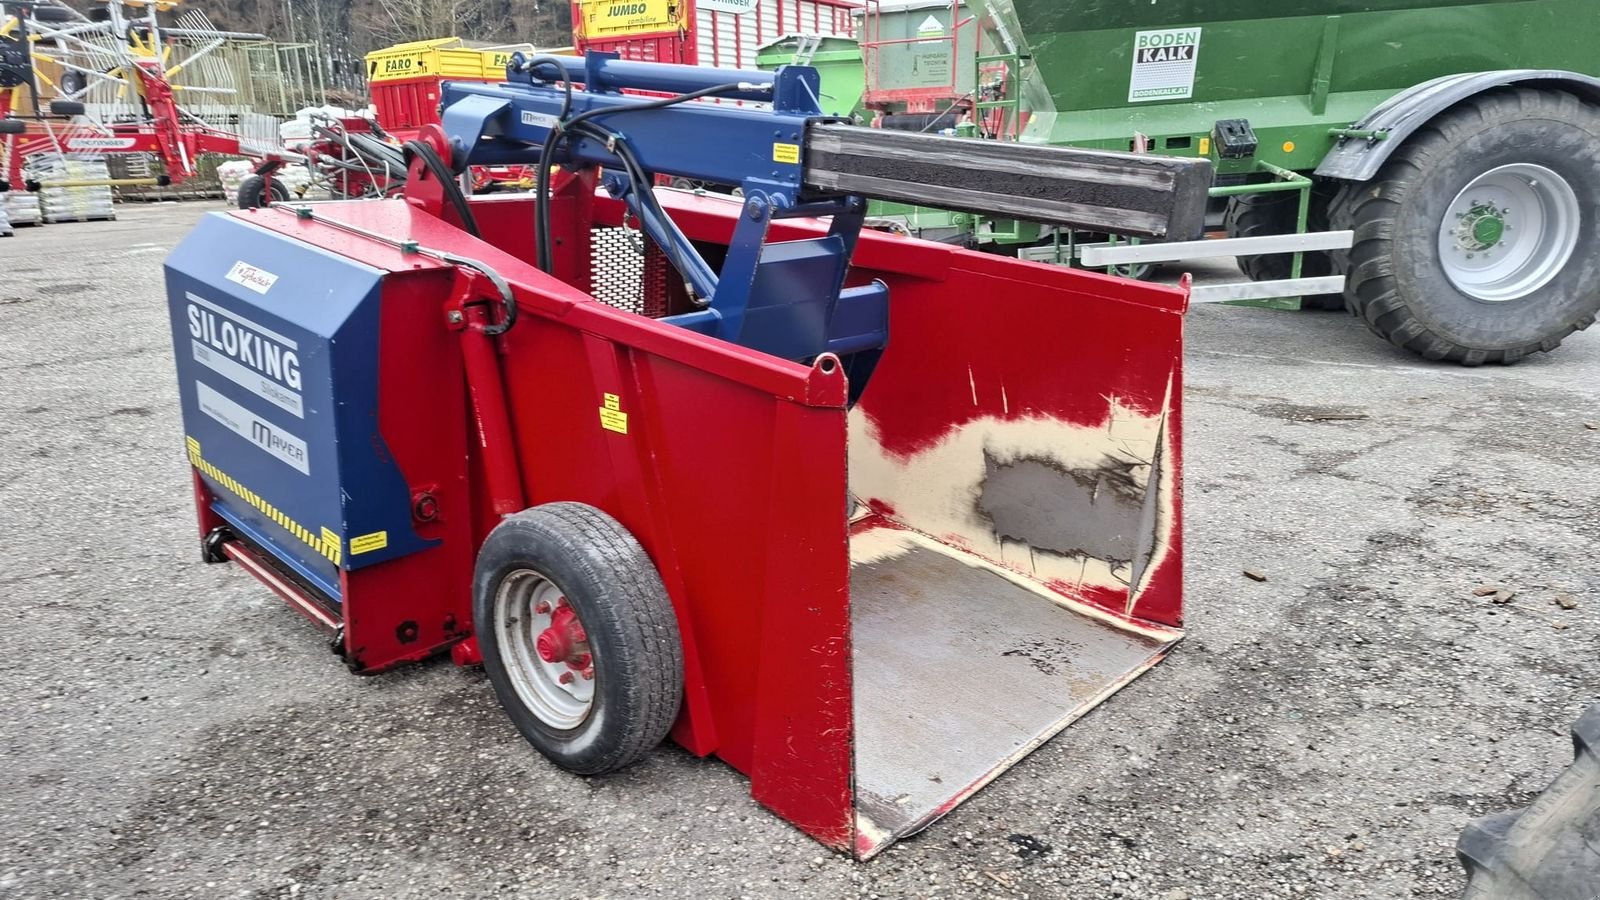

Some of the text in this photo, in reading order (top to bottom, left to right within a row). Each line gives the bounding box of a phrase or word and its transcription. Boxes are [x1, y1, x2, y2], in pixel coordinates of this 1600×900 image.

[607, 2, 647, 17] JUMBO
[628, 15, 656, 25] combiline
[1139, 31, 1196, 47] BODEN
[1142, 46, 1189, 62] KALK
[385, 58, 411, 72] FARO
[187, 303, 302, 391] SILOKING
[252, 420, 304, 462] MAYER
